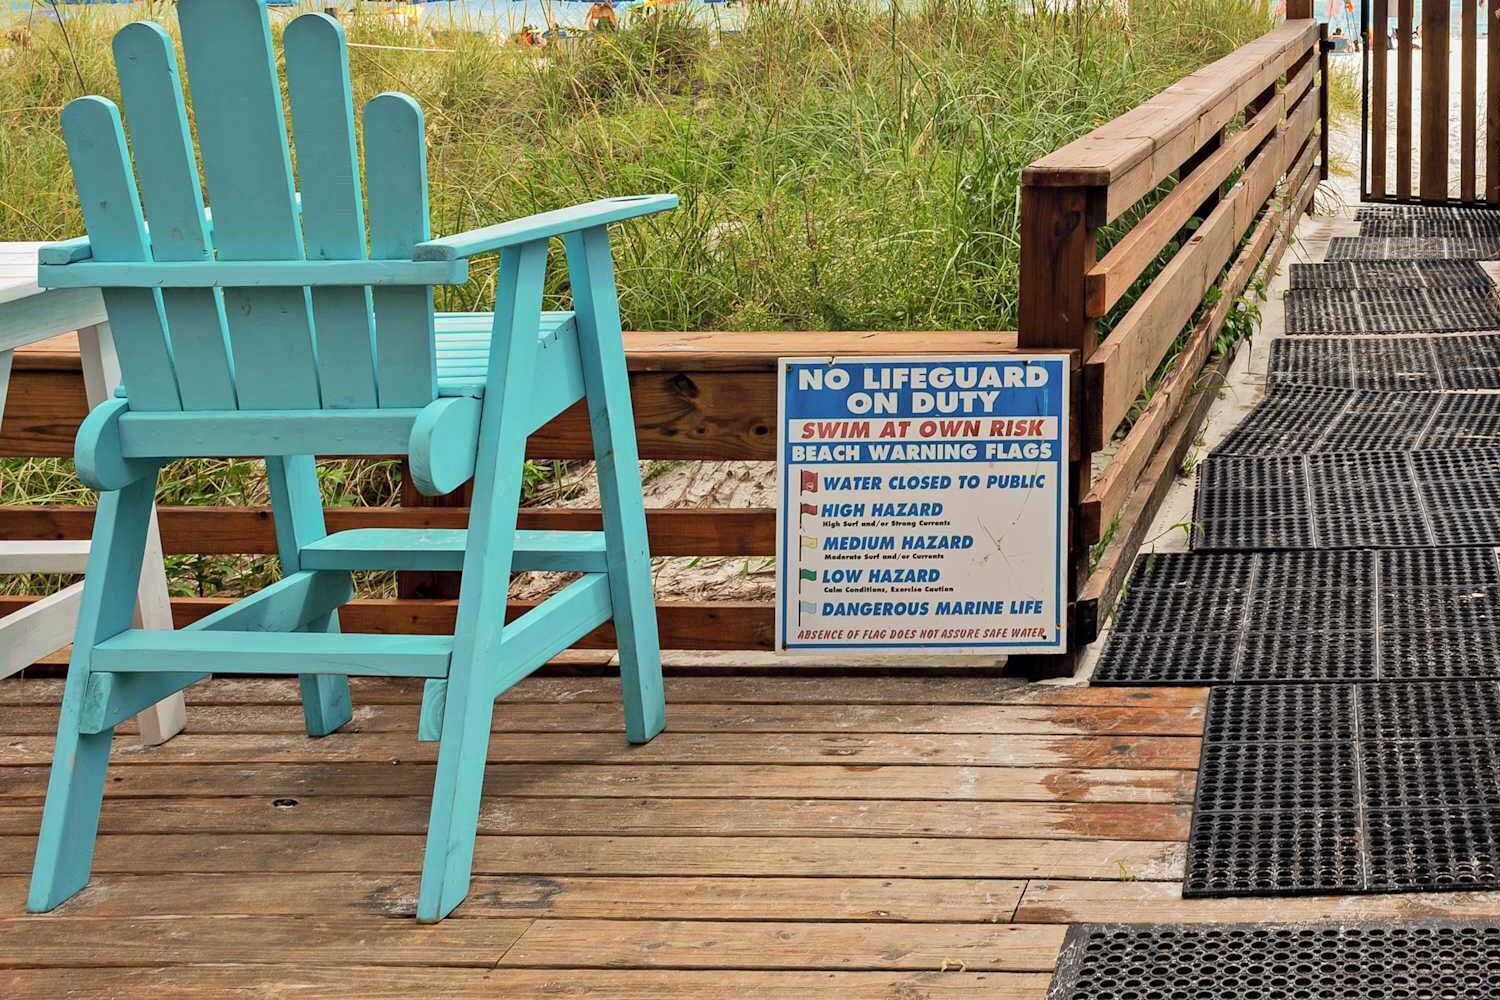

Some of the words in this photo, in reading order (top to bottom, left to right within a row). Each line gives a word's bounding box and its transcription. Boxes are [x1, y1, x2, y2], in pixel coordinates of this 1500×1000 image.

[799, 368, 850, 390] NO
[864, 366, 1049, 389] LIFEGUARD
[847, 392, 898, 414] ON
[912, 391, 1000, 413] DUTY
[801, 422, 870, 439] SWIM
[880, 421, 911, 438] AT
[919, 420, 980, 438] OWN
[989, 419, 1046, 437] RISK
[792, 445, 860, 461] BEACH
[868, 443, 978, 461] WARNING
[985, 442, 1052, 459] FLAGS
[823, 476, 882, 490] WATER
[888, 475, 952, 490] CLOSED
[959, 475, 980, 488] TO
[986, 474, 1046, 489] PUBLIC
[821, 503, 865, 517] HIGH
[871, 502, 943, 517] HAZARD
[861, 520, 888, 528] and/or
[891, 520, 916, 528] Strong
[823, 536, 895, 550] MEDIUM
[901, 535, 974, 550] HAZARD
[882, 552, 910, 560] and/or
[822, 569, 863, 583] LOW
[868, 568, 941, 583] HAZARD
[822, 602, 929, 616] DANGEROUS
[935, 601, 1004, 615] MARINE
[1009, 600, 1043, 614] LIFE
[797, 629, 844, 640] ABSENCE
[847, 629, 860, 639] OF
[862, 629, 887, 639] FLAG
[890, 629, 917, 639] DOES
[920, 629, 940, 639] NOT
[941, 628, 980, 639] ASSURE
[983, 628, 1009, 638] SAFE
